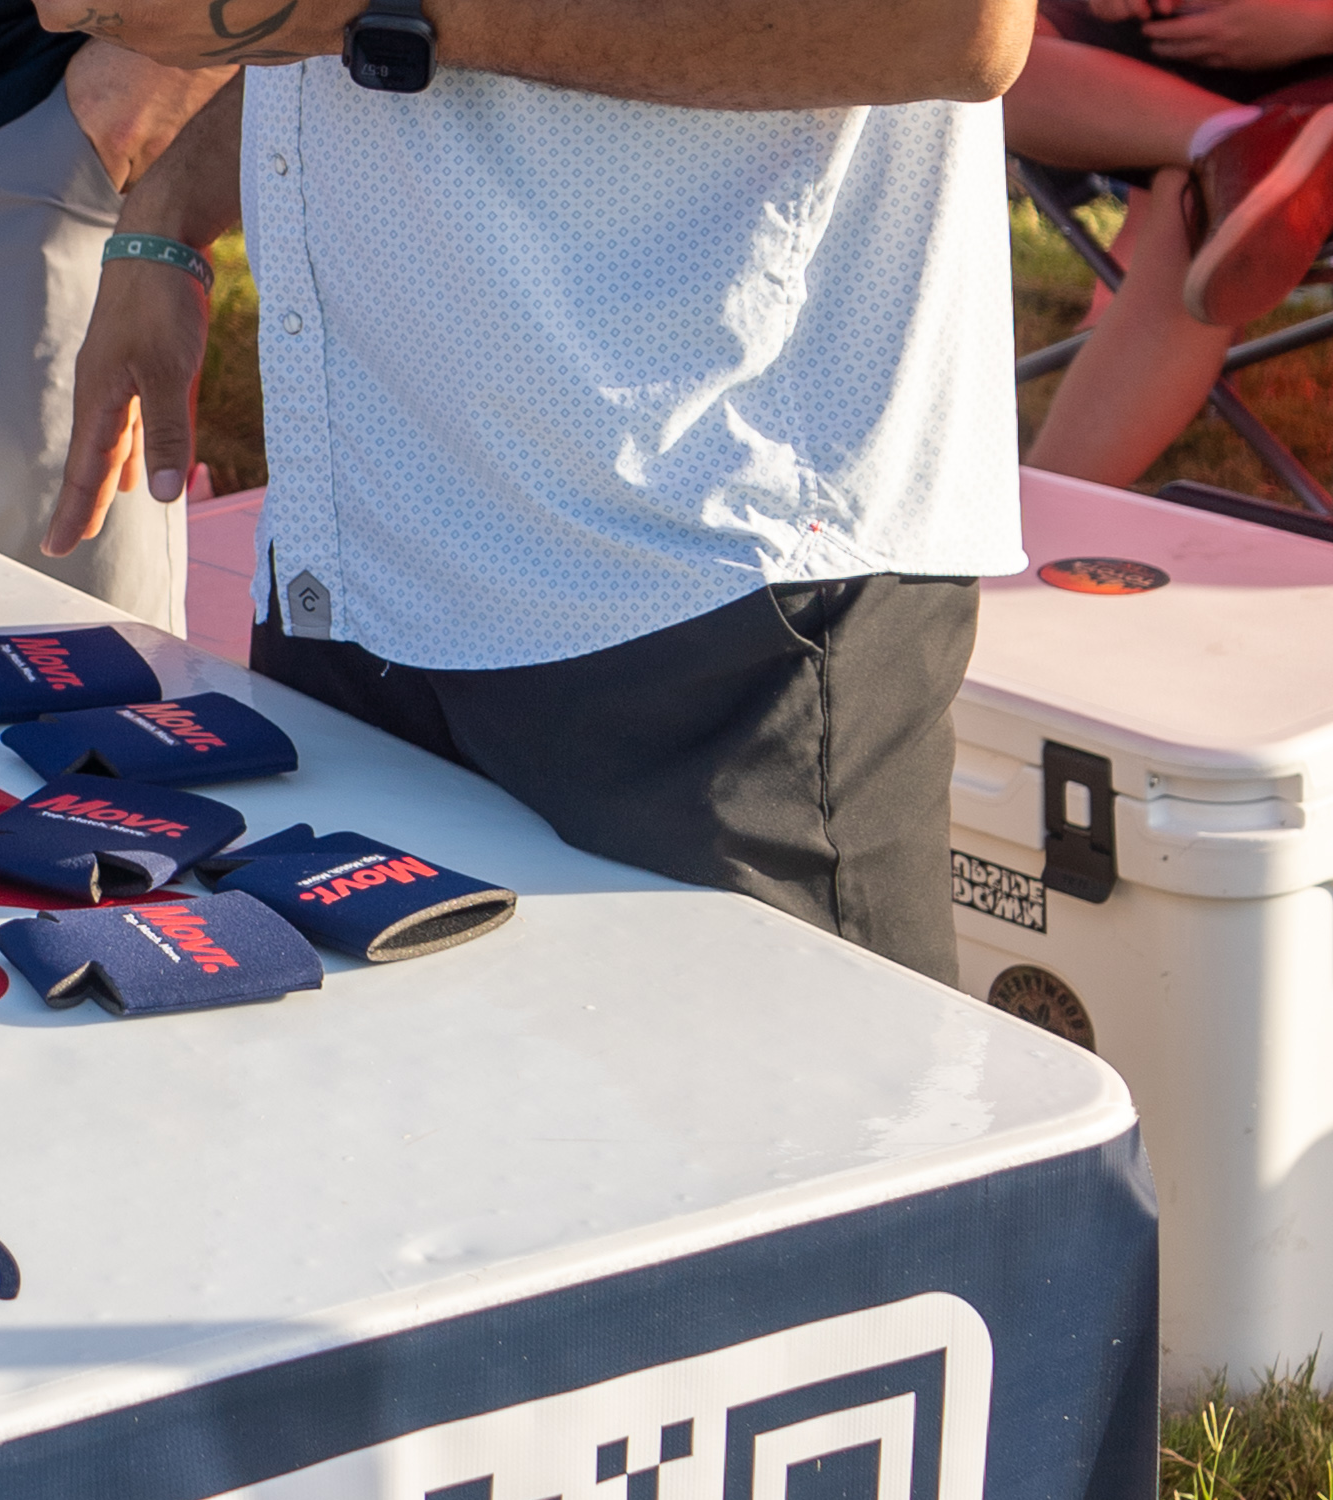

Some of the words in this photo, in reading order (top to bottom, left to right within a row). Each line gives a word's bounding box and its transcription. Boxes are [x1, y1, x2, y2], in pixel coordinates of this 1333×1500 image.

[10, 637, 84, 690] Movr.
[126, 702, 227, 753] Movr.
[28, 794, 190, 839] Movr.
[299, 856, 440, 905] Movr.
[130, 905, 240, 974] Movr.
[993, 971, 1086, 1032] HERRYWOOD
